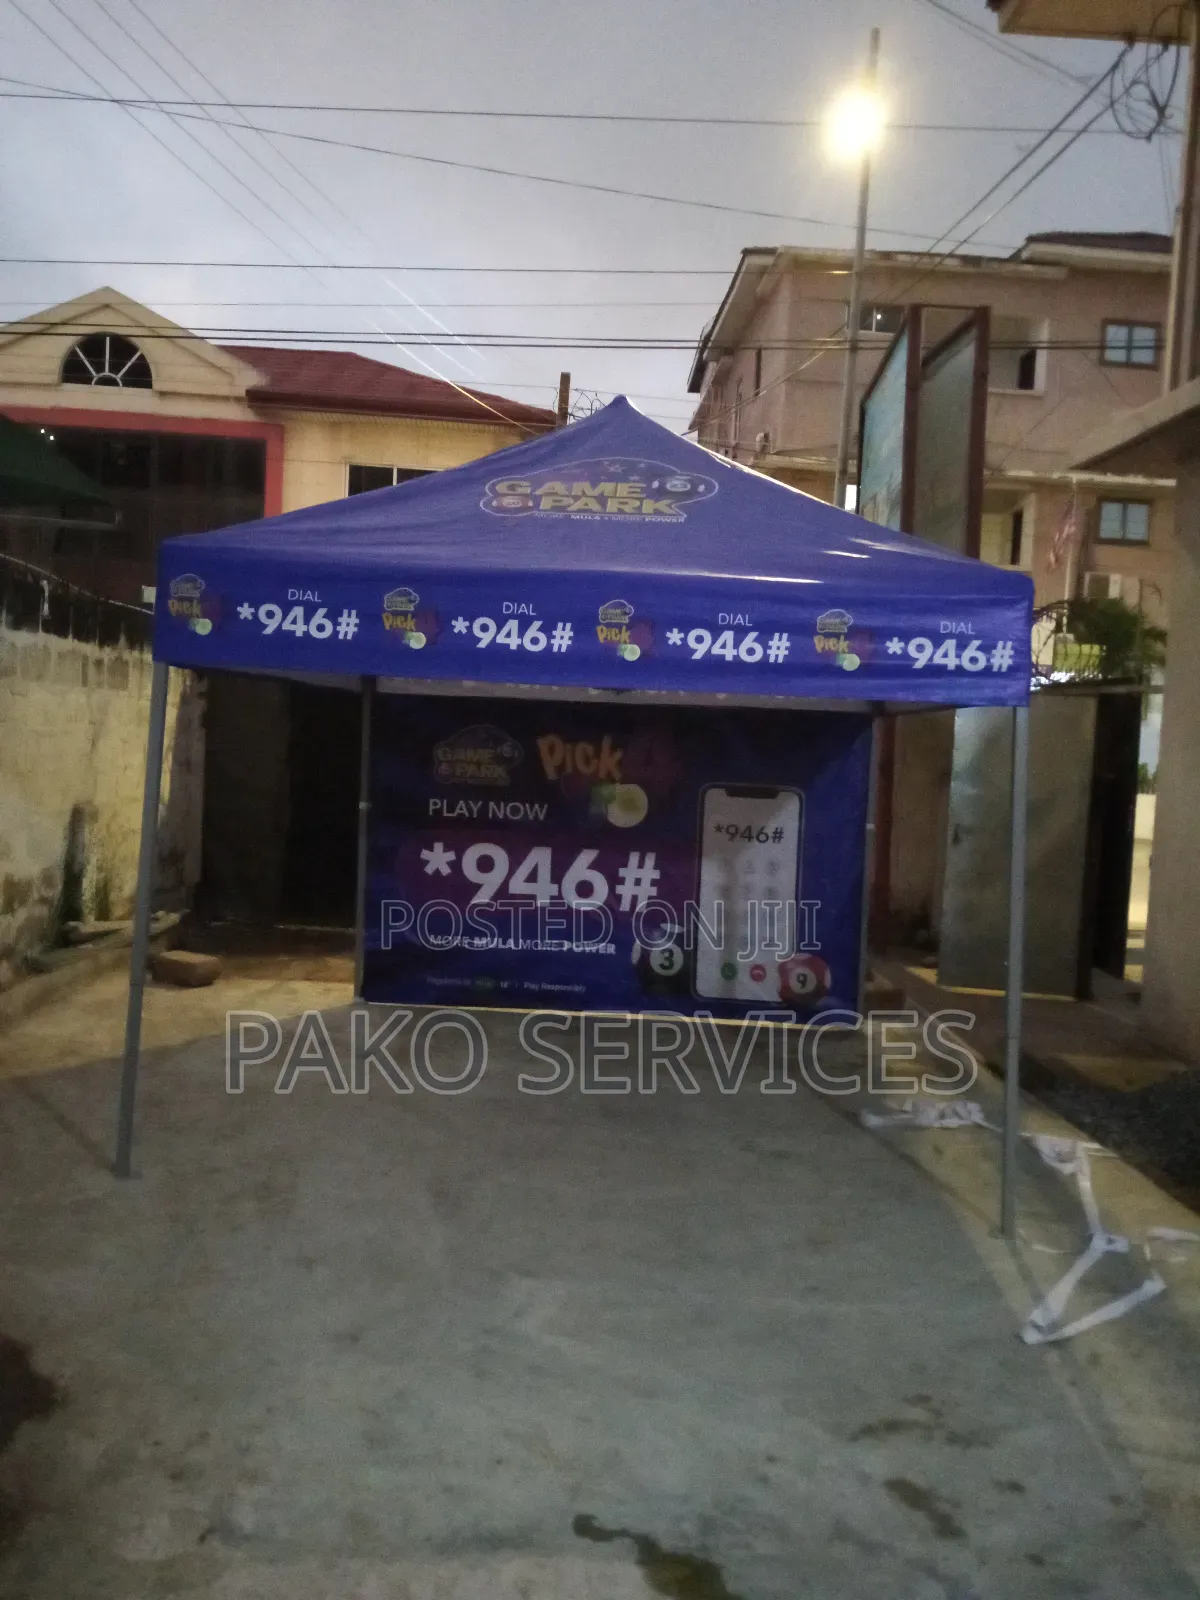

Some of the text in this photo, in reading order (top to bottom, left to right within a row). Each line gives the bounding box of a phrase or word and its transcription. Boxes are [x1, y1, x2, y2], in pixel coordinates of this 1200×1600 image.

[496, 480, 647, 498] GAME
[540, 496, 677, 514] PARK
[287, 588, 322, 603] DIAL
[502, 601, 537, 616] DIAL
[718, 612, 753, 627] DIAL
[939, 620, 976, 635] DIAL
[437, 748, 496, 763] GAME
[537, 734, 623, 781] Pick
[456, 763, 508, 779] PARK
[429, 798, 549, 821] PLAY NOW
[564, 941, 616, 955] POWER
[659, 950, 676, 972] 3
